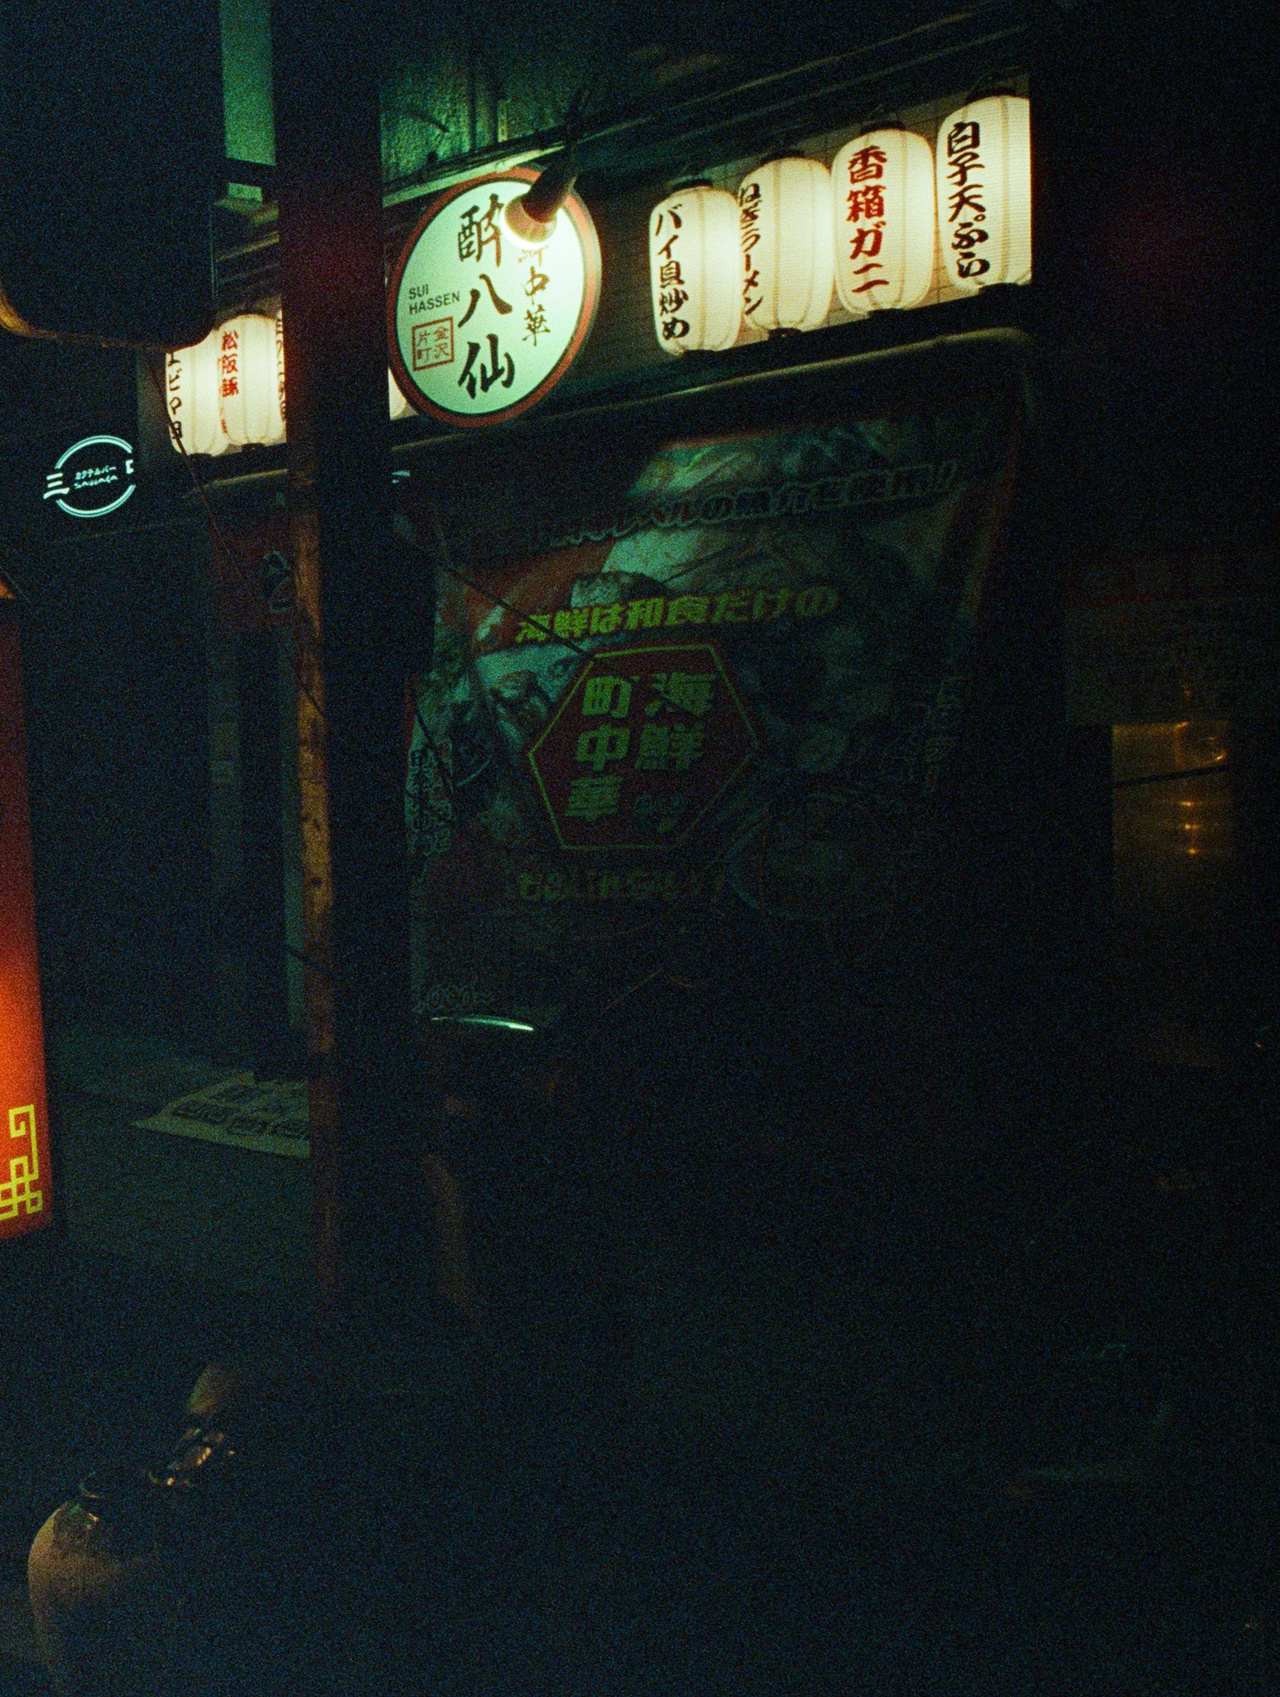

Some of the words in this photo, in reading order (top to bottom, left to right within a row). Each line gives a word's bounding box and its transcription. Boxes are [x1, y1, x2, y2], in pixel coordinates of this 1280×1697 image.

[846, 145, 890, 293] 香箱ガニ
[947, 121, 991, 279] 白子天ぷら
[409, 284, 429, 301] SUI
[409, 291, 460, 315] HASSEN
[458, 193, 516, 400] 酔八仙
